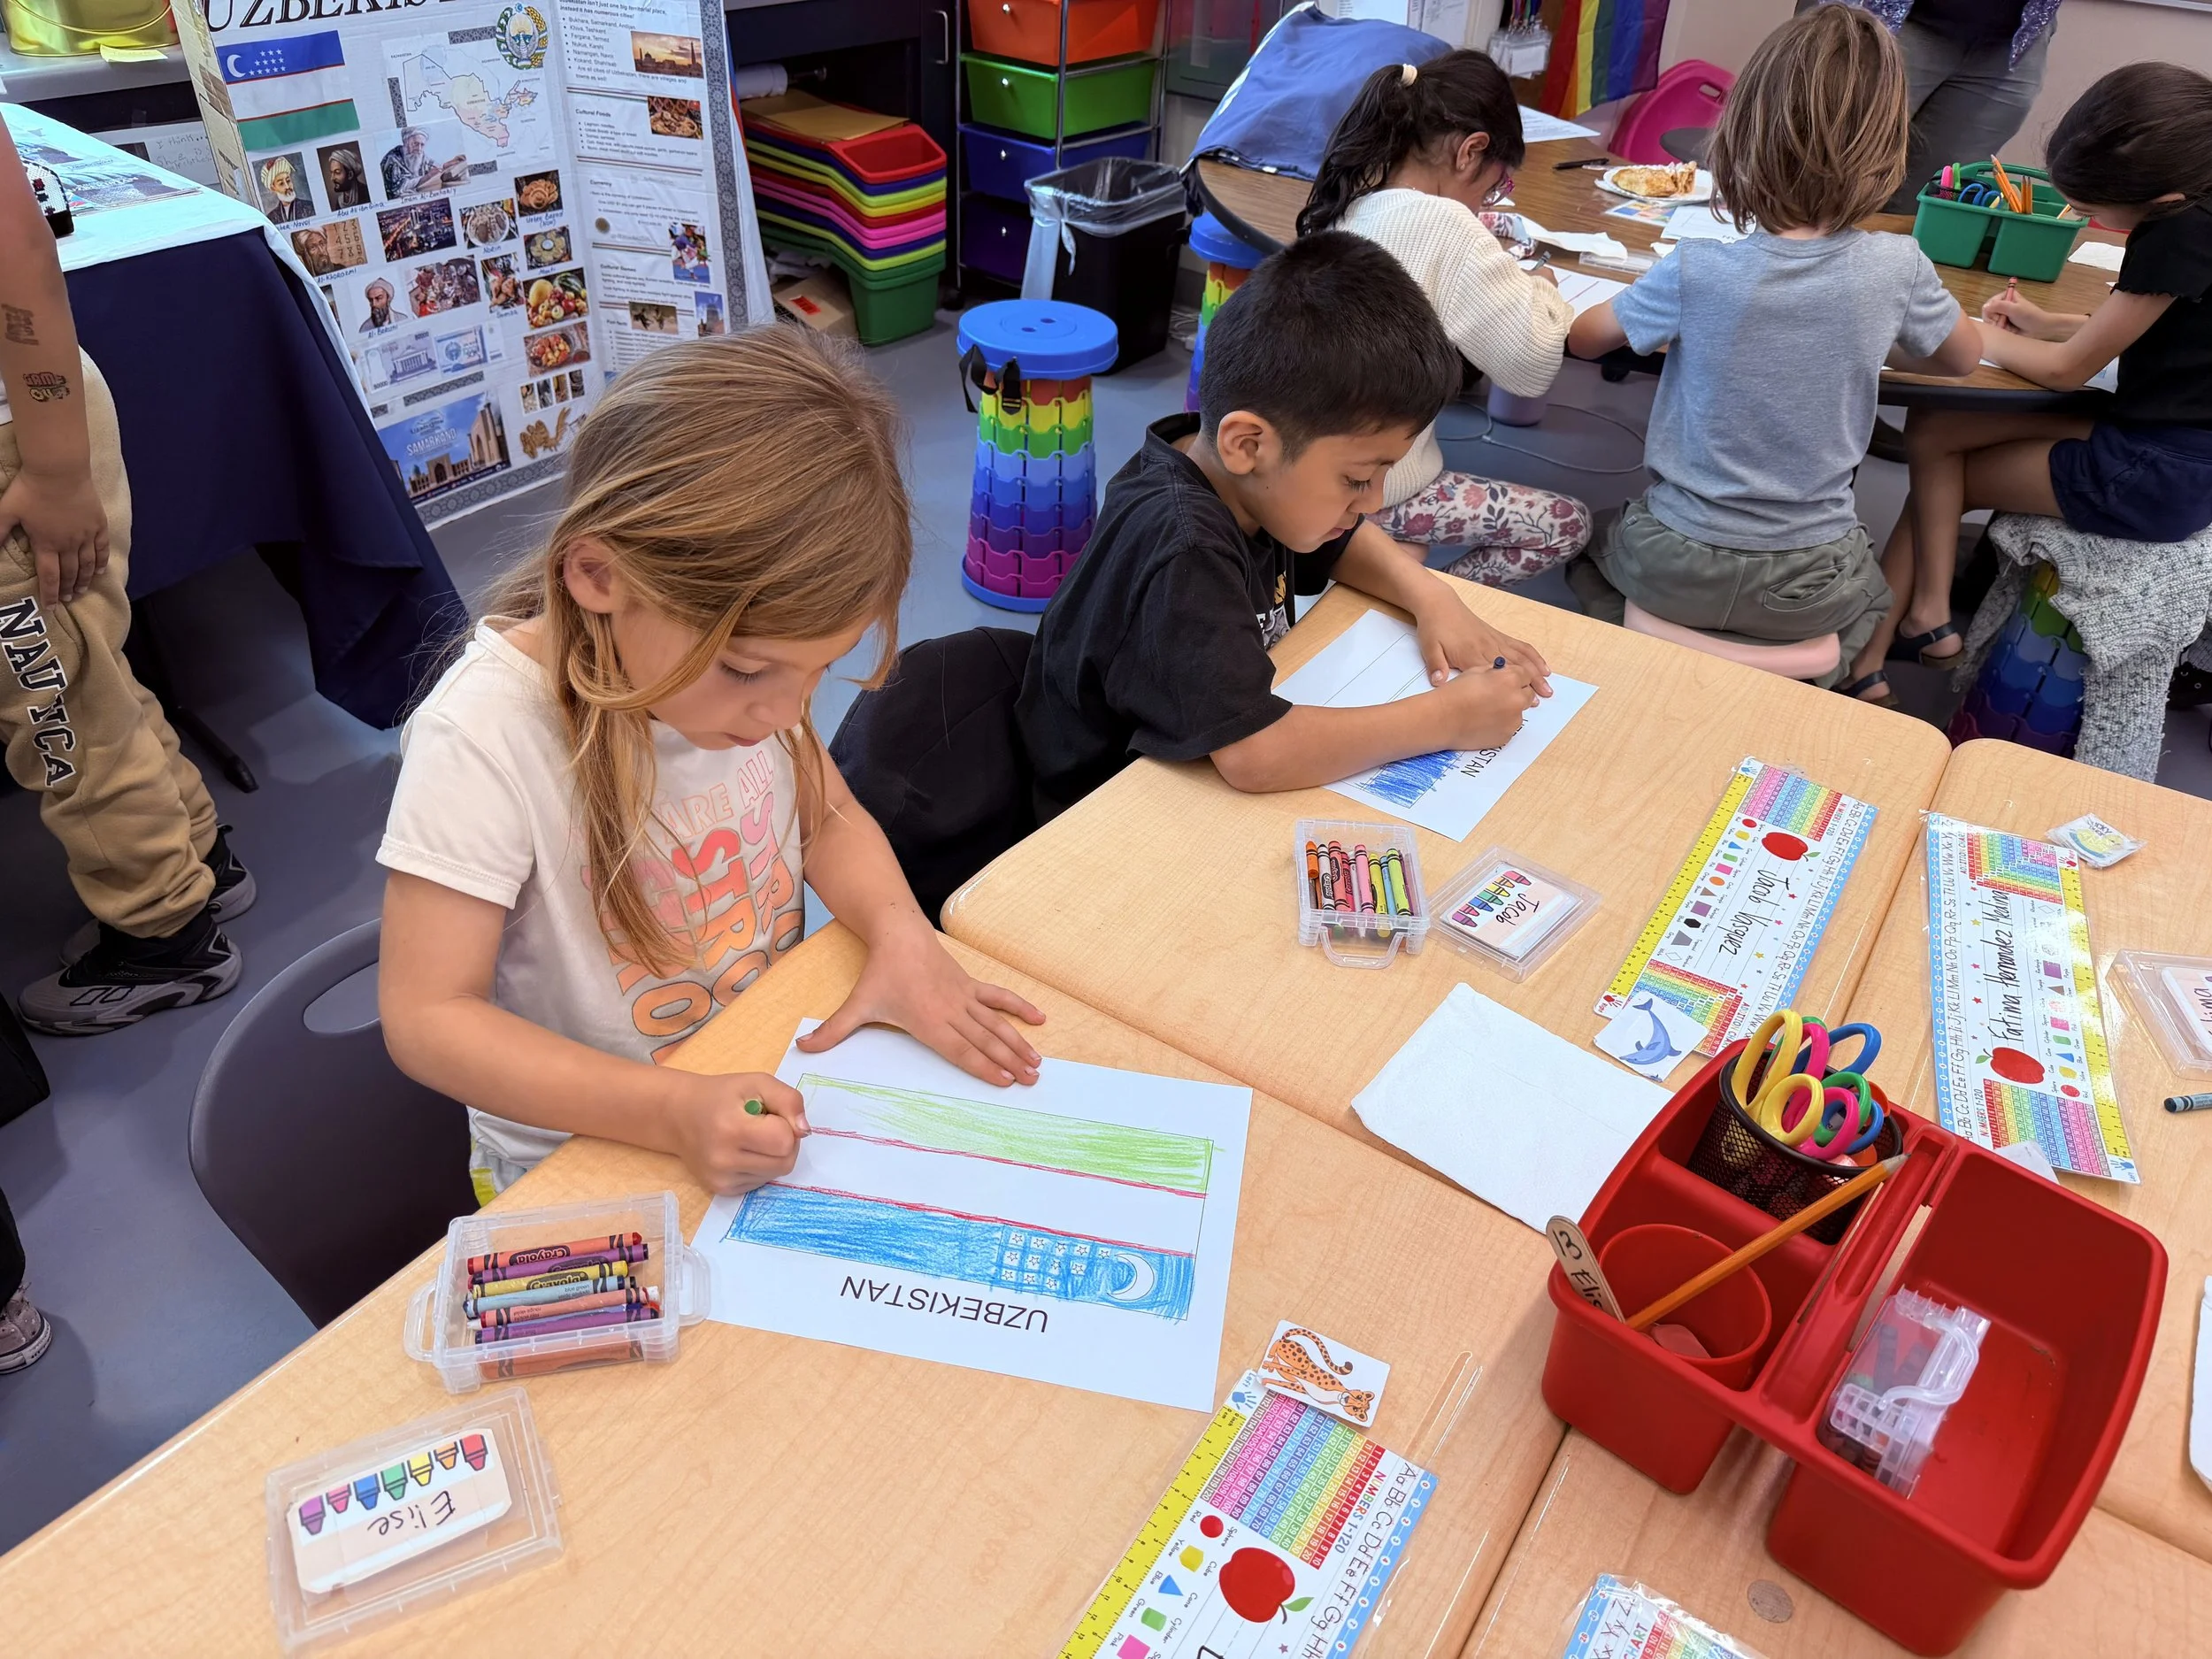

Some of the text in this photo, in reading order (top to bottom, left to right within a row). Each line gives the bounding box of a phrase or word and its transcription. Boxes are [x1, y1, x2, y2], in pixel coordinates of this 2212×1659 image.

[736, 750, 774, 810] ALL
[1750, 869, 1791, 907] Jacob
[1495, 893, 1540, 926] Jacob
[1718, 911, 1773, 956] Vasquez
[1978, 889, 2024, 1042] Fatima Hernandez Medina
[515, 1248, 567, 1265] Crayola
[841, 1274, 1048, 1333] UZBEKISTAN
[1242, 1372, 1256, 1387] Left
[1396, 1462, 1417, 1486] Aa
[1200, 1486, 1213, 1502] 120
[1220, 1498, 1233, 1513] 100
[1385, 1486, 1407, 1509] Bb
[367, 1490, 457, 1536] Elise
[1230, 1506, 1242, 1518] 90
[1334, 1471, 1386, 1555] NUMBERS 1-120
[1371, 1511, 1393, 1531] Cc
[1359, 1532, 1382, 1557] Dd
[1312, 1555, 1322, 1565] 10
[1346, 1556, 1369, 1578] Ee
[1110, 1509, 1202, 1647] Red Yellow Blue Green Pink
[1163, 1526, 1237, 1643] Sphere Cube Cone Cylinder
[1334, 1580, 1357, 1607] Ff
[1310, 1605, 1342, 1632] Gg
[1599, 1615, 1632, 1646] Yy
[1647, 1633, 1659, 1646] 10
